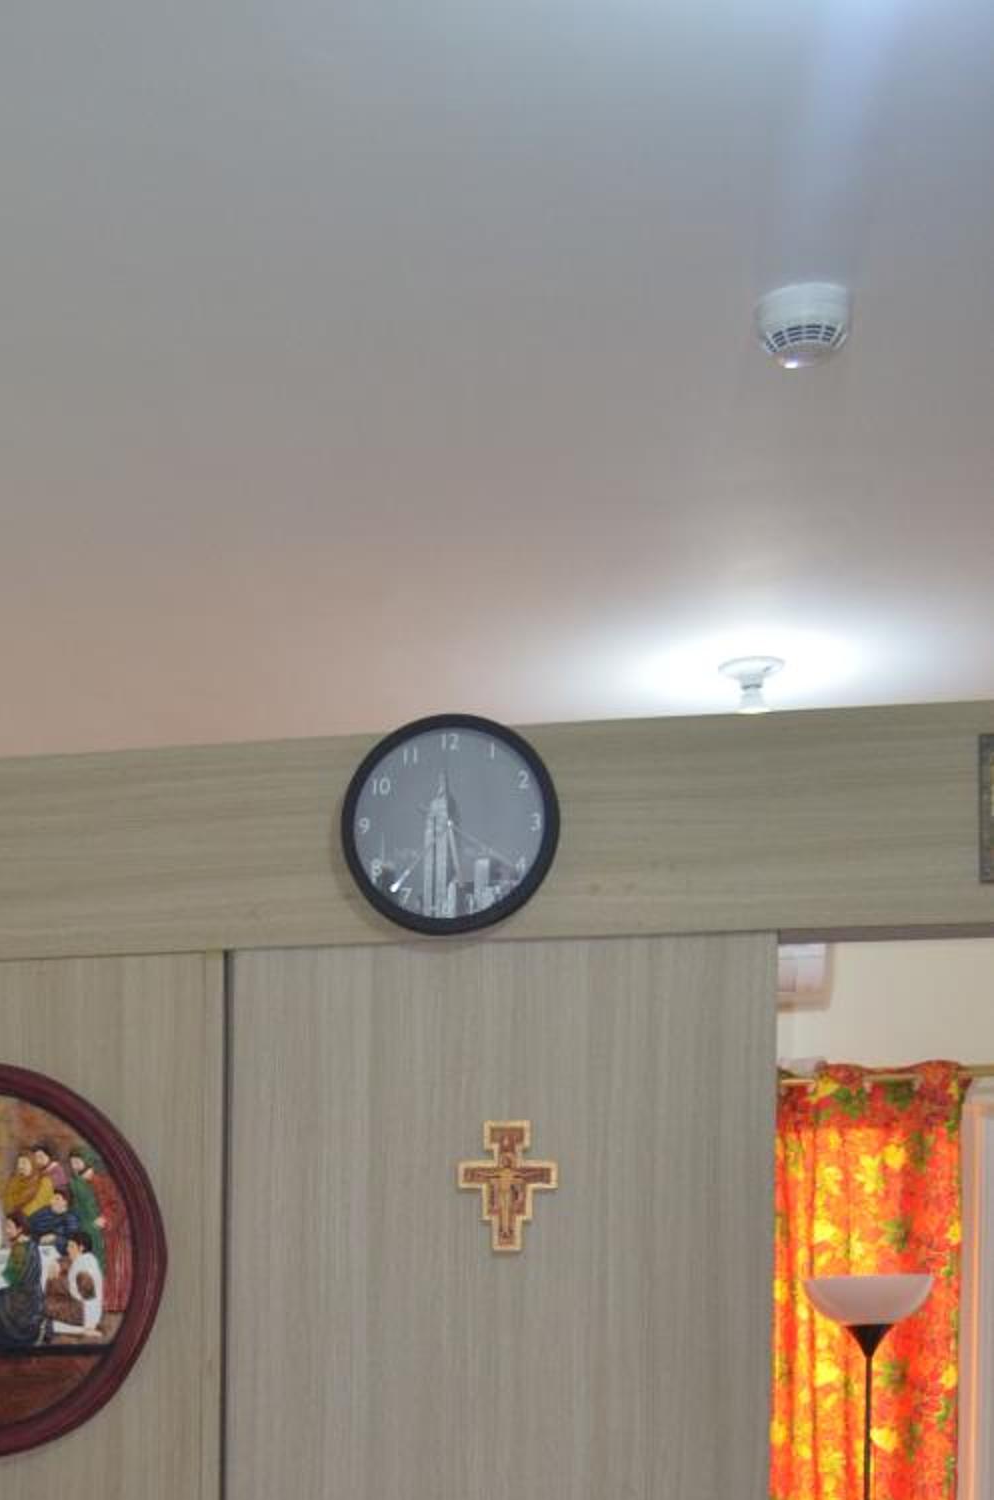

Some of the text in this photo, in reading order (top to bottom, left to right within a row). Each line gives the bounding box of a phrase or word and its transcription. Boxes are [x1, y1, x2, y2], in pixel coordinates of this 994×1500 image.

[441, 732, 460, 751] 12
[402, 746, 418, 765] 11
[370, 777, 391, 796] 10
[517, 768, 530, 790] 2
[357, 816, 371, 834] 9
[529, 811, 542, 833] 3
